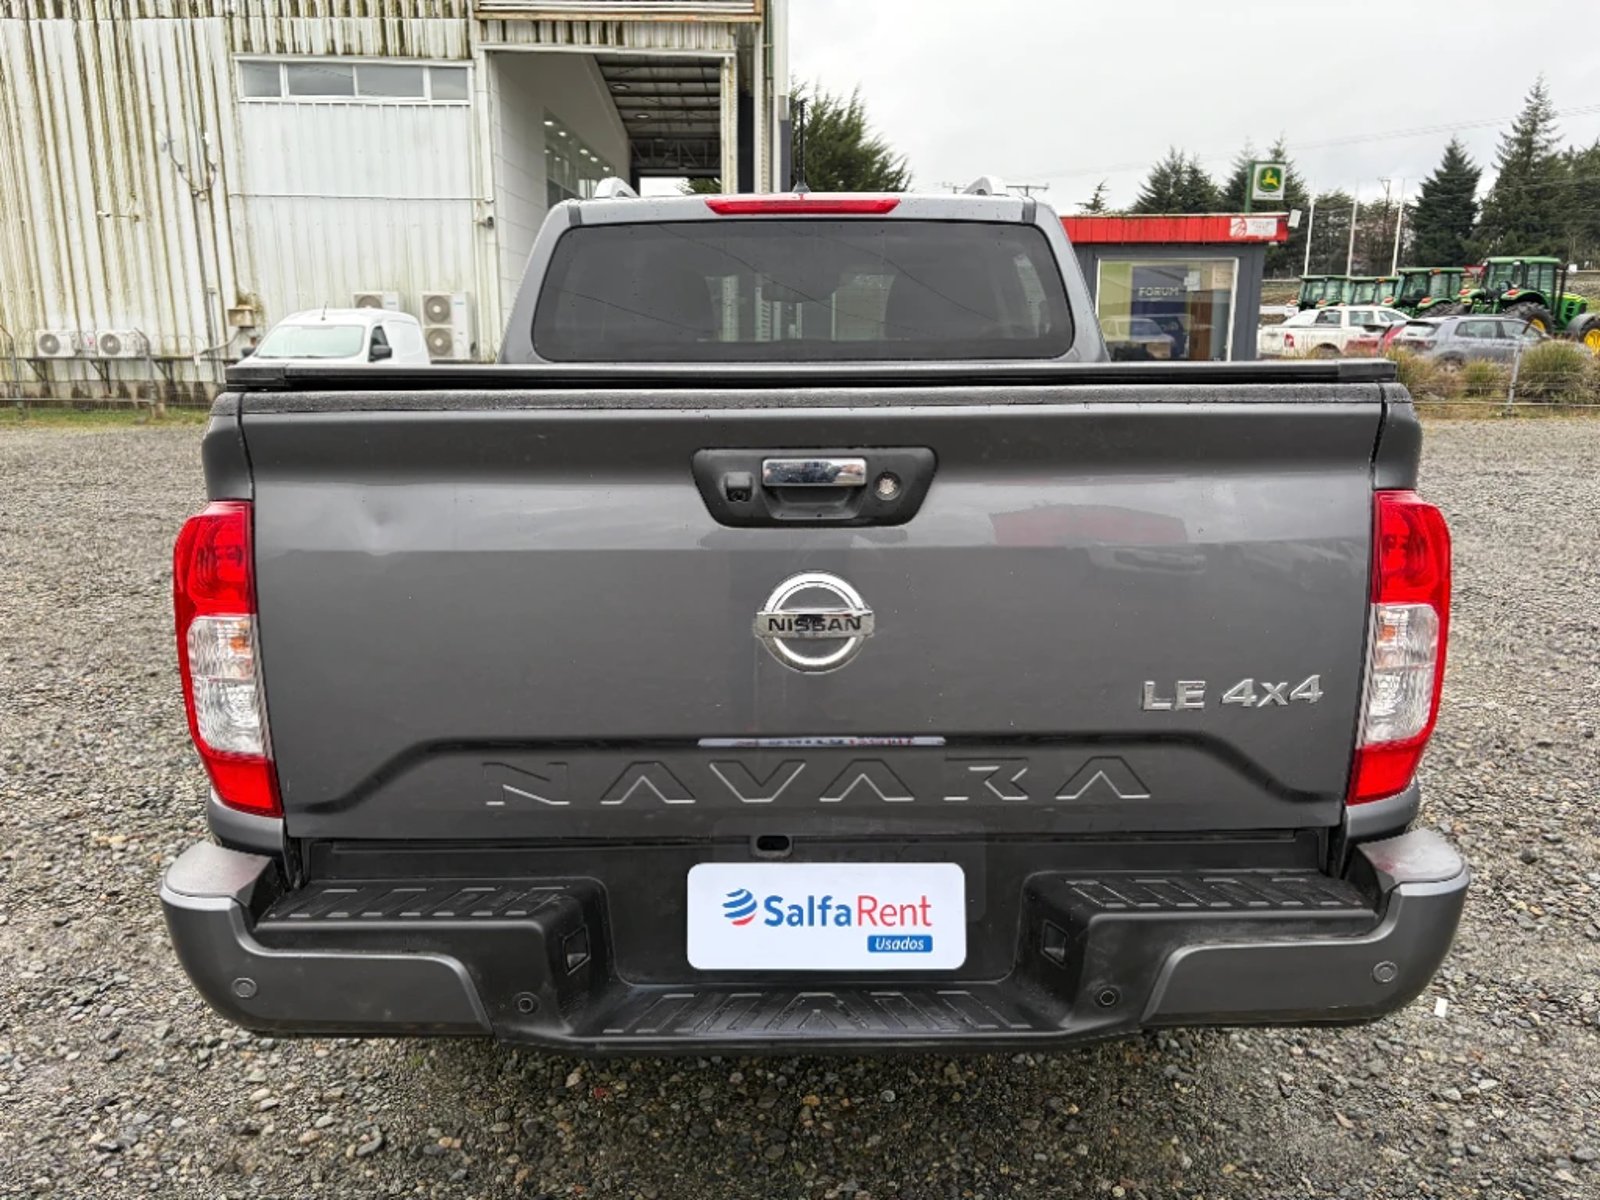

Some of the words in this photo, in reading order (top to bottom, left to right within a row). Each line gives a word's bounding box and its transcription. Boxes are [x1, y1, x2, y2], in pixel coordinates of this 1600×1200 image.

[1138, 287, 1179, 296] FORUM
[768, 617, 862, 632] NISSAN
[1142, 680, 1206, 711] LE
[482, 755, 1151, 806] NAVARA
[763, 894, 932, 928] SalfaRent
[874, 936, 925, 951] Usados
